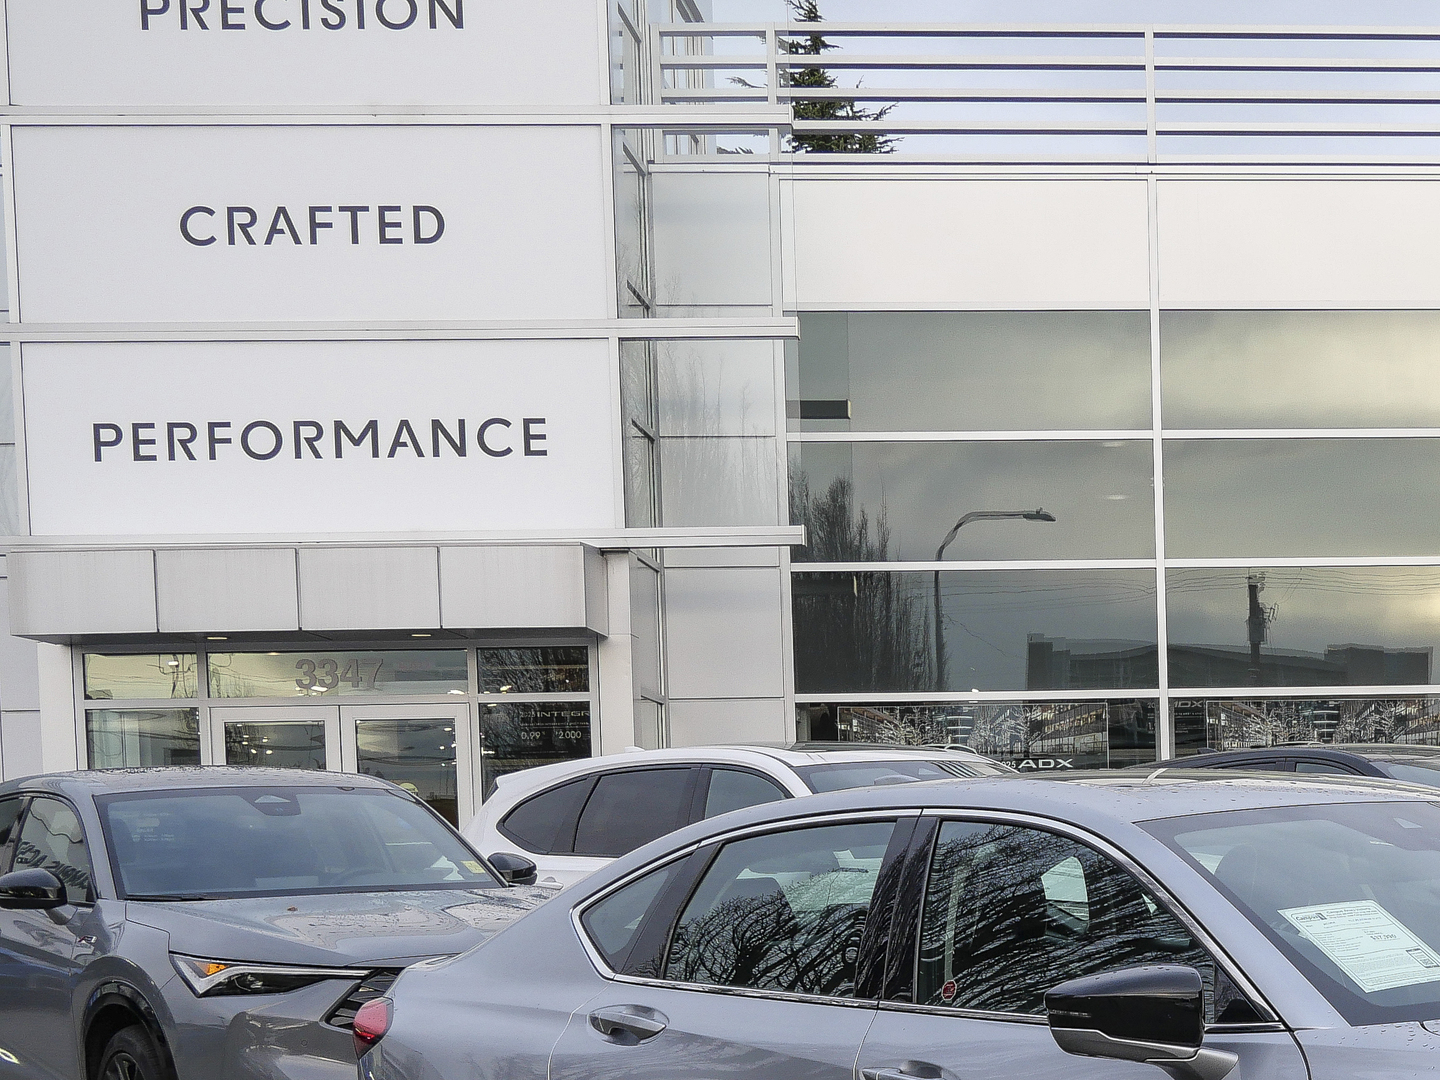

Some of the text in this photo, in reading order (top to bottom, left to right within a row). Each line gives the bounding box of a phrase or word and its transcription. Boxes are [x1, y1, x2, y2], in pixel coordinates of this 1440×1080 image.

[141, 0, 464, 30] PRECISION
[179, 205, 445, 246] CRAFTED
[92, 417, 548, 462] PERFORMANCE
[295, 658, 383, 690] 3347
[536, 710, 590, 718] INTEGR
[1018, 758, 1074, 769] ADX
